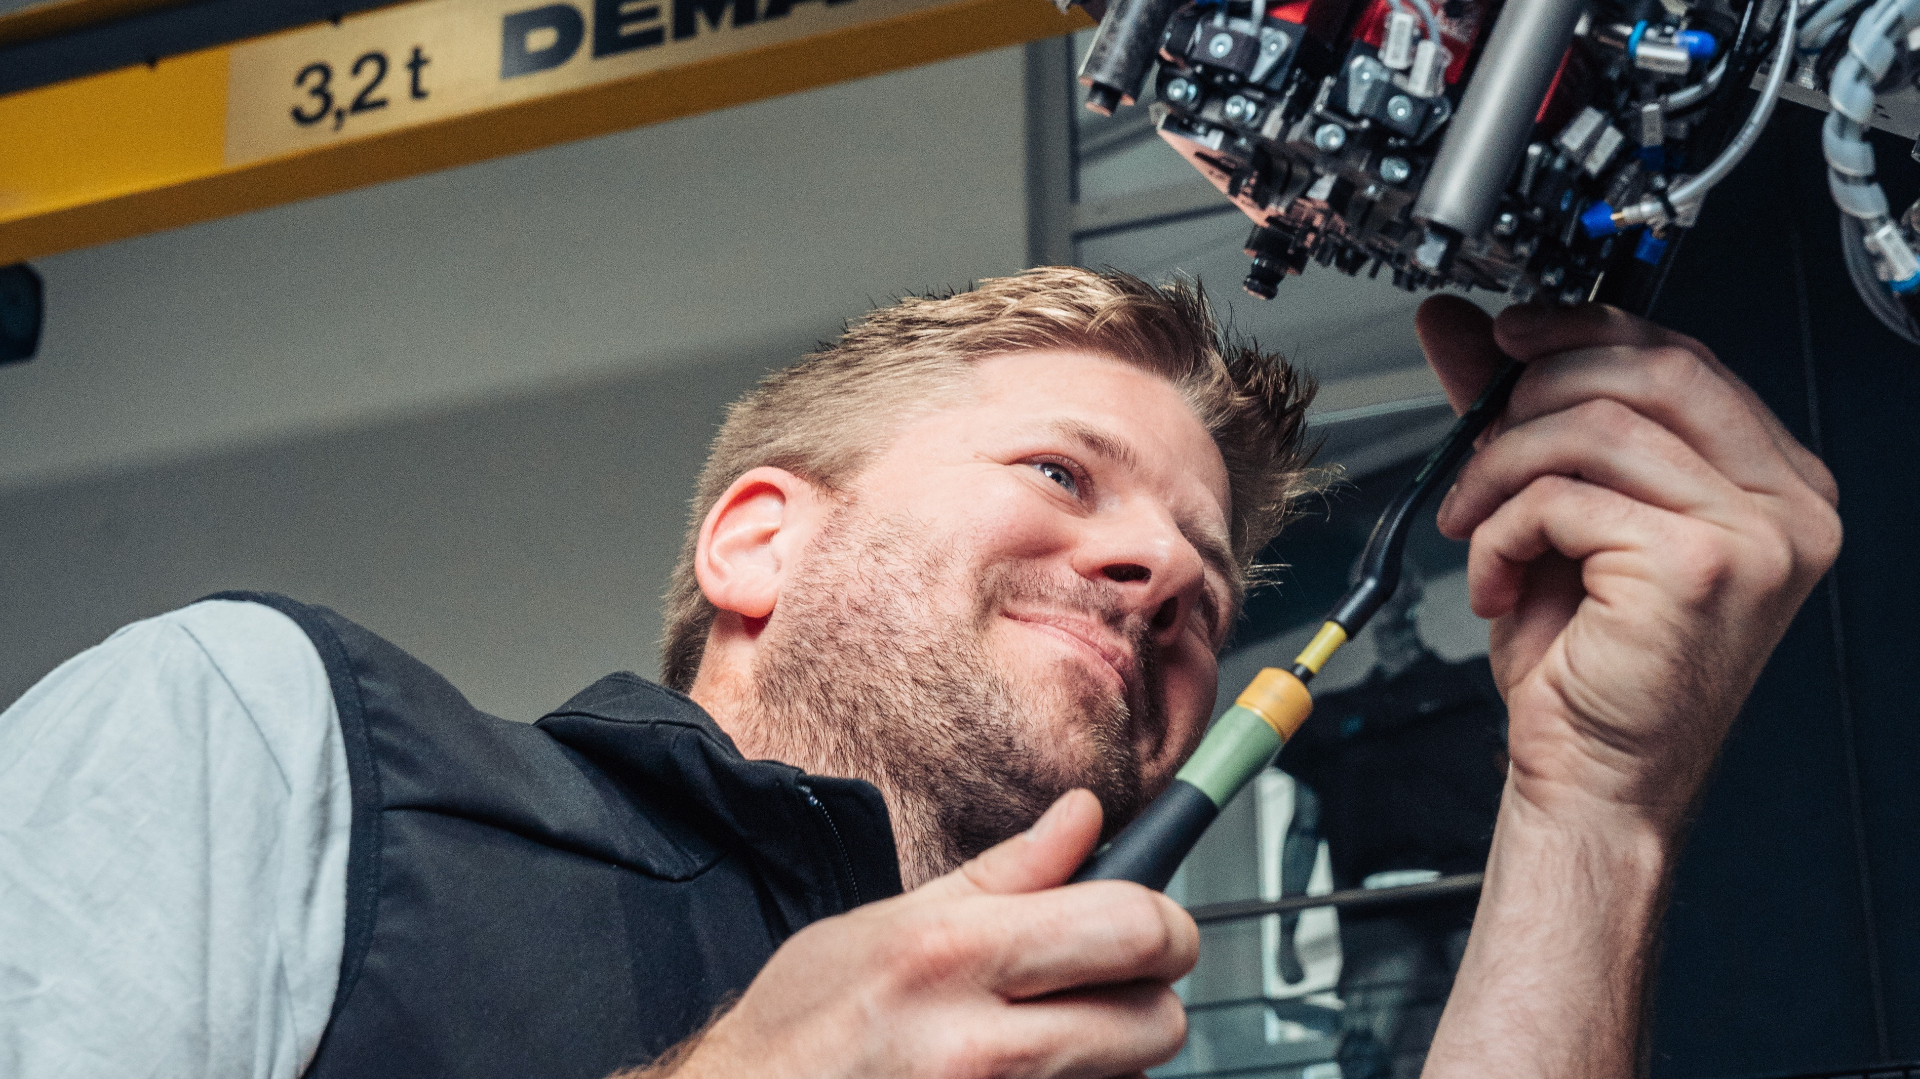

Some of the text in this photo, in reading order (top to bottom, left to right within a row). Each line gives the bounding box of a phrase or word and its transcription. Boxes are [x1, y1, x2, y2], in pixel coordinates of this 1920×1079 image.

[500, 0, 854, 79] DEM
[290, 45, 431, 132] 3,2 t
